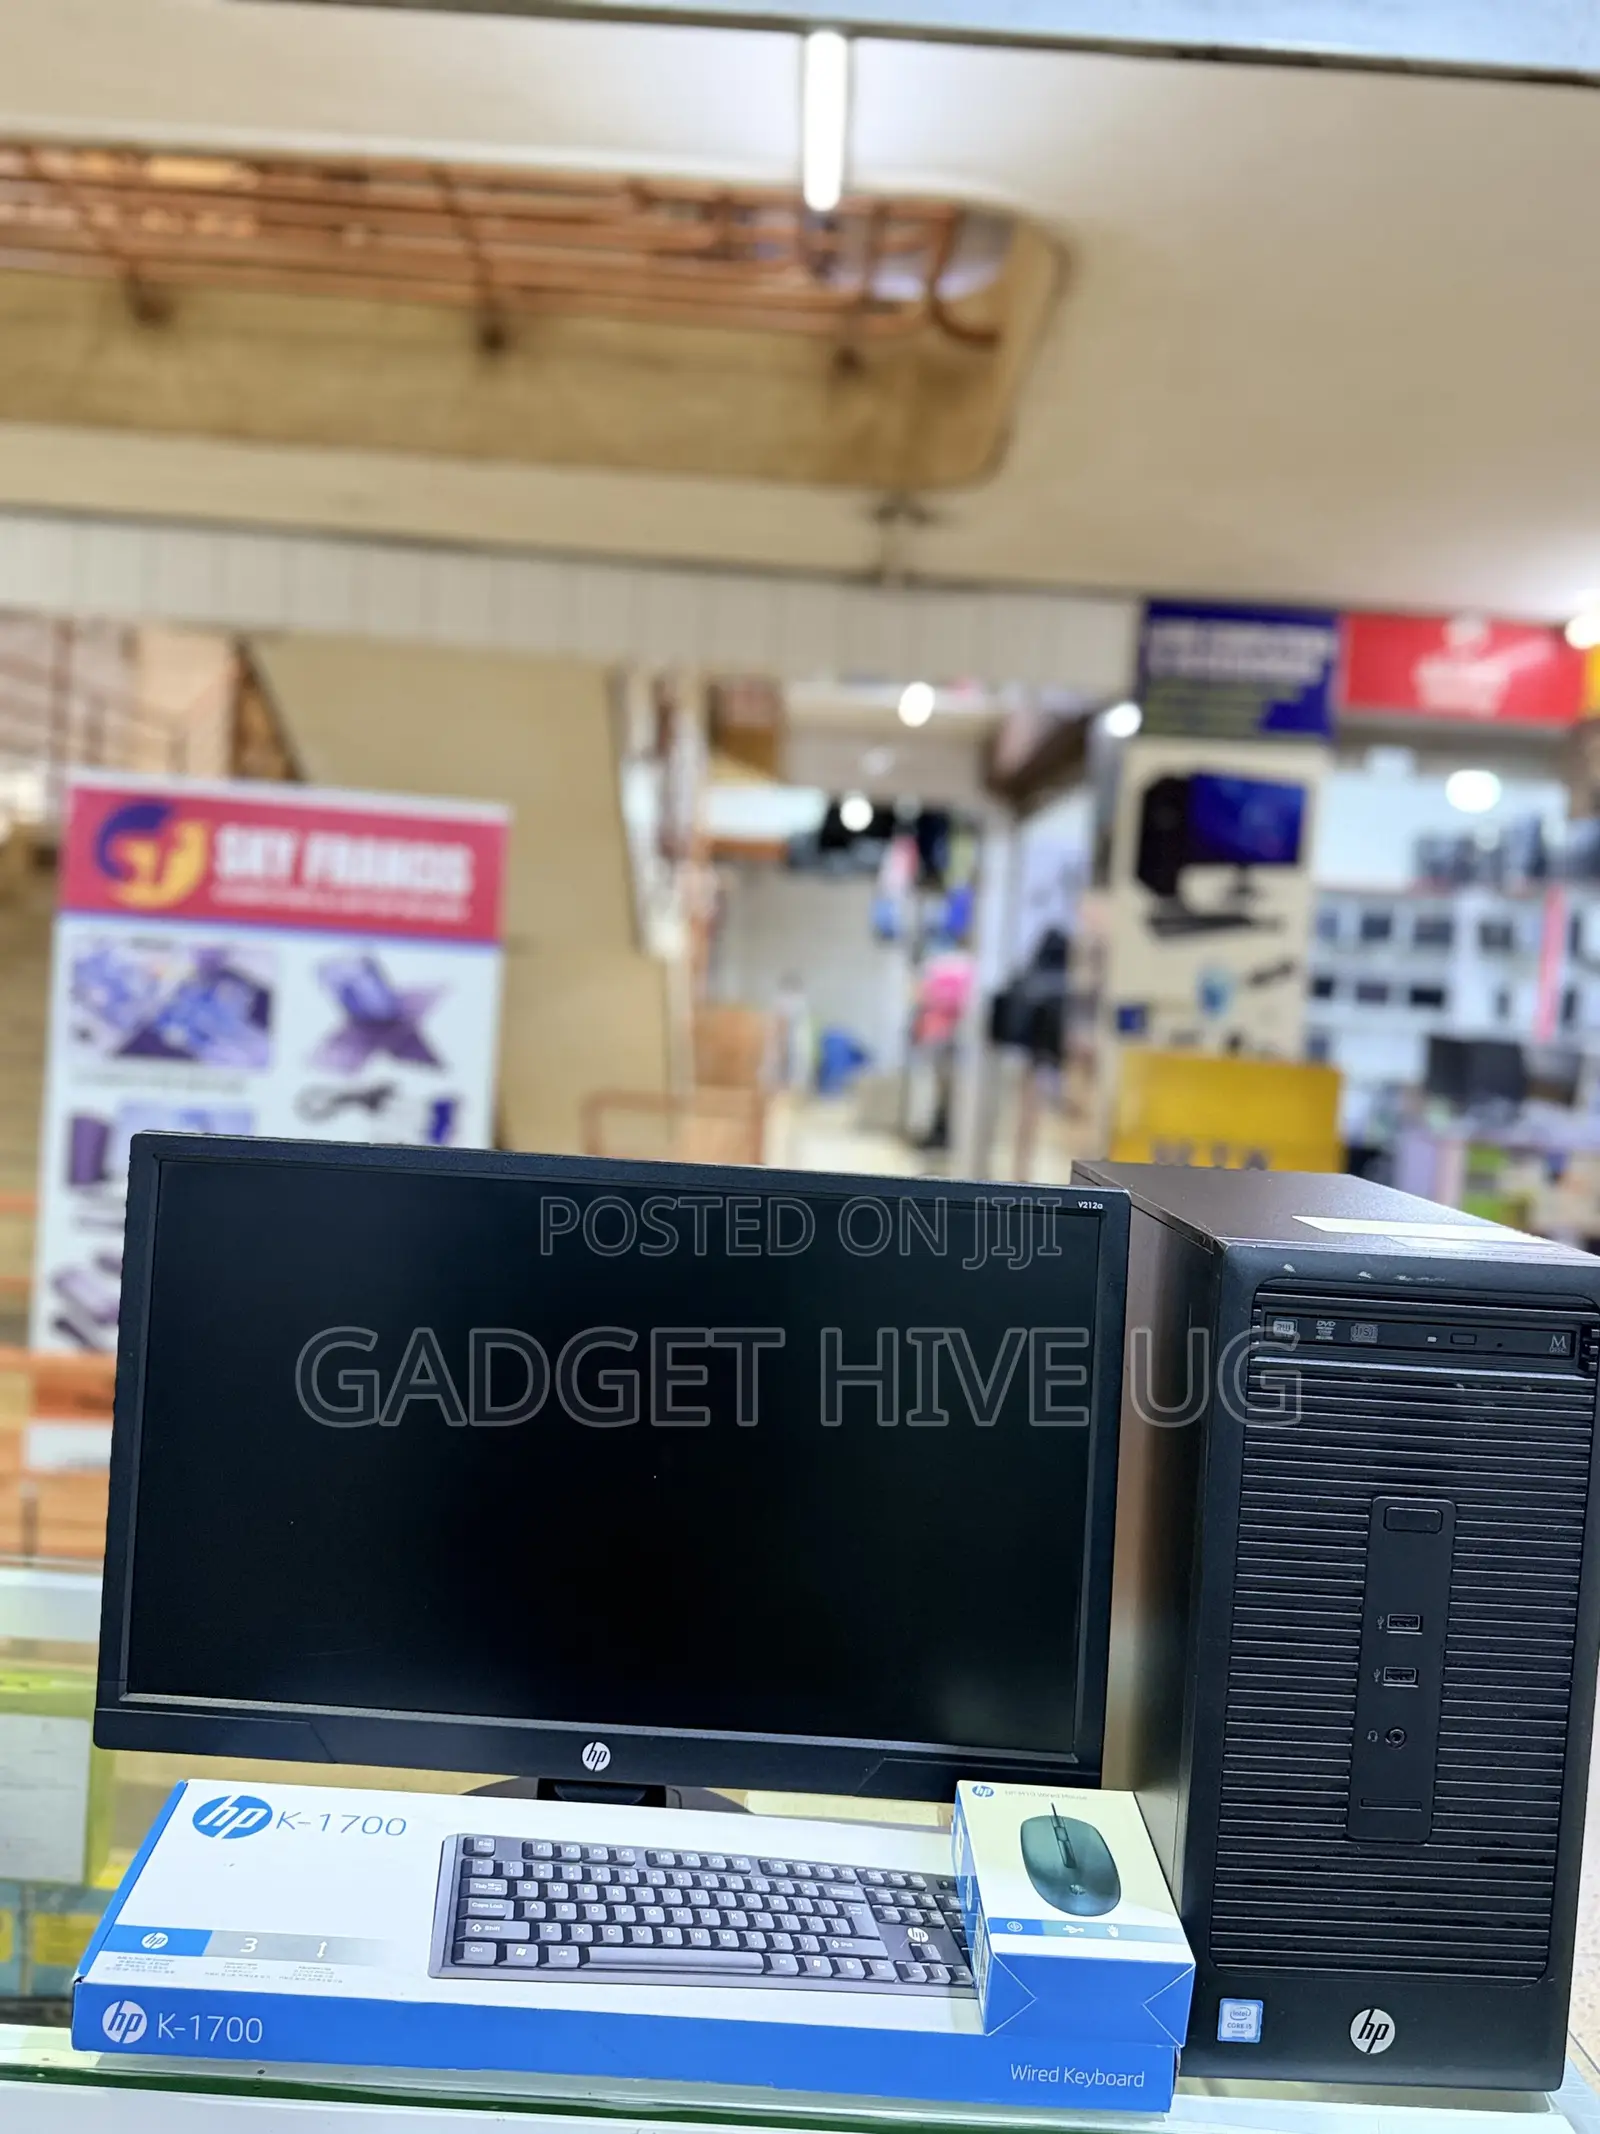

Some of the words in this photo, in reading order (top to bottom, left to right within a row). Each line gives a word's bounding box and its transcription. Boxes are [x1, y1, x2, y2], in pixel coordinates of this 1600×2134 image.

[582, 1742, 610, 1771] hp
[971, 1785, 995, 1798] hp
[192, 1795, 273, 1839] hp
[276, 1811, 407, 1836] K-1700
[142, 1932, 168, 1949] hp
[637, 1929, 645, 1937] V
[907, 1928, 928, 1942] hp
[239, 1937, 258, 1953] 3
[102, 2000, 147, 2044] hp
[158, 2012, 263, 2043] K-1700
[1351, 2008, 1395, 2054] hp
[1010, 2063, 1060, 2083] Wired
[1063, 2067, 1145, 2088] Keyboard
